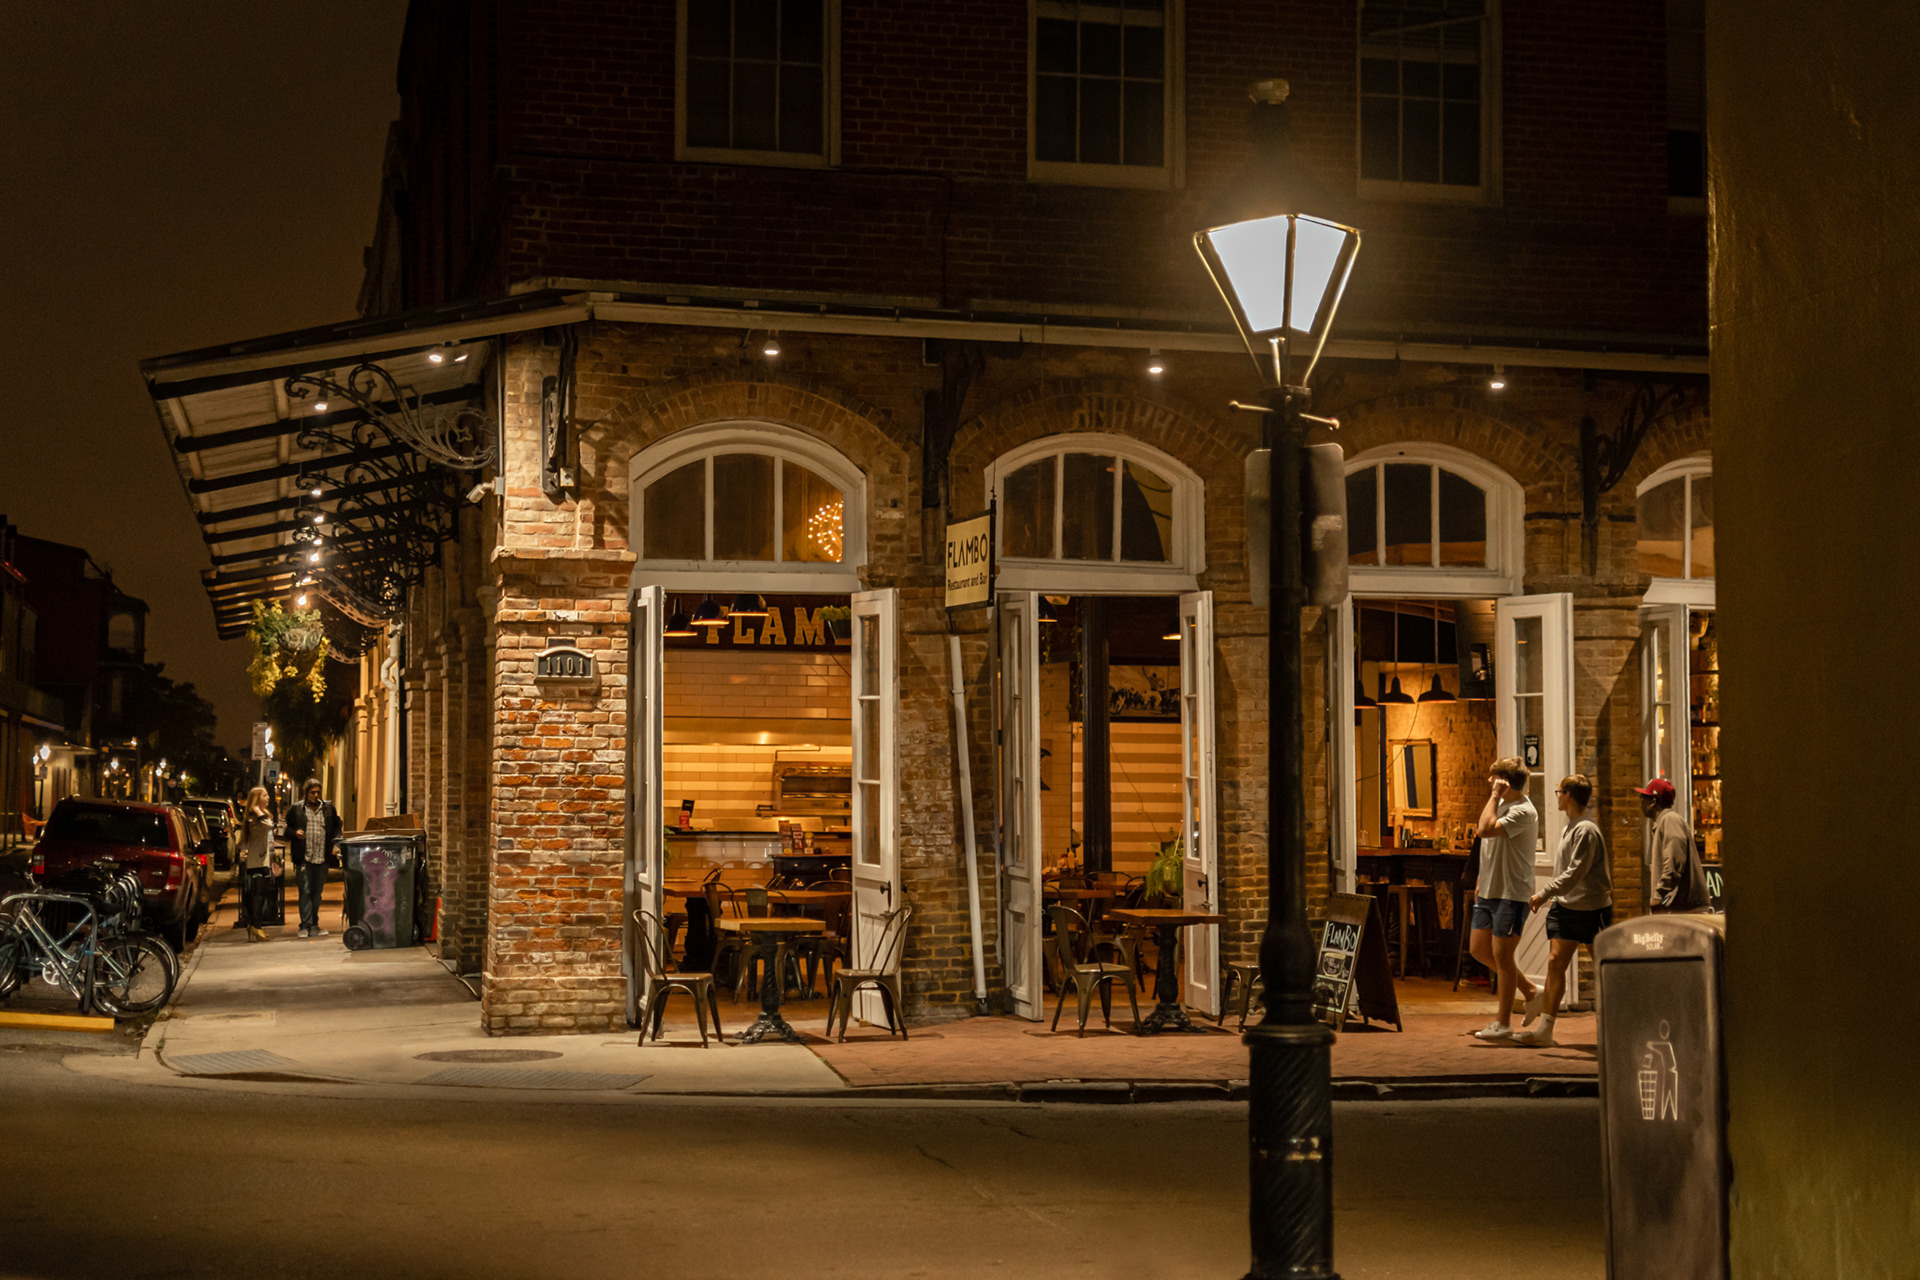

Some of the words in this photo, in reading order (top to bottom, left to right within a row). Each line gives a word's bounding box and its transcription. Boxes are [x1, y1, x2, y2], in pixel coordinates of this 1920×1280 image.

[948, 533, 988, 569] FLAMBO
[947, 578, 970, 591] Restaurant
[970, 573, 979, 586] and
[979, 572, 988, 585] Bar
[546, 656, 584, 674] 1101
